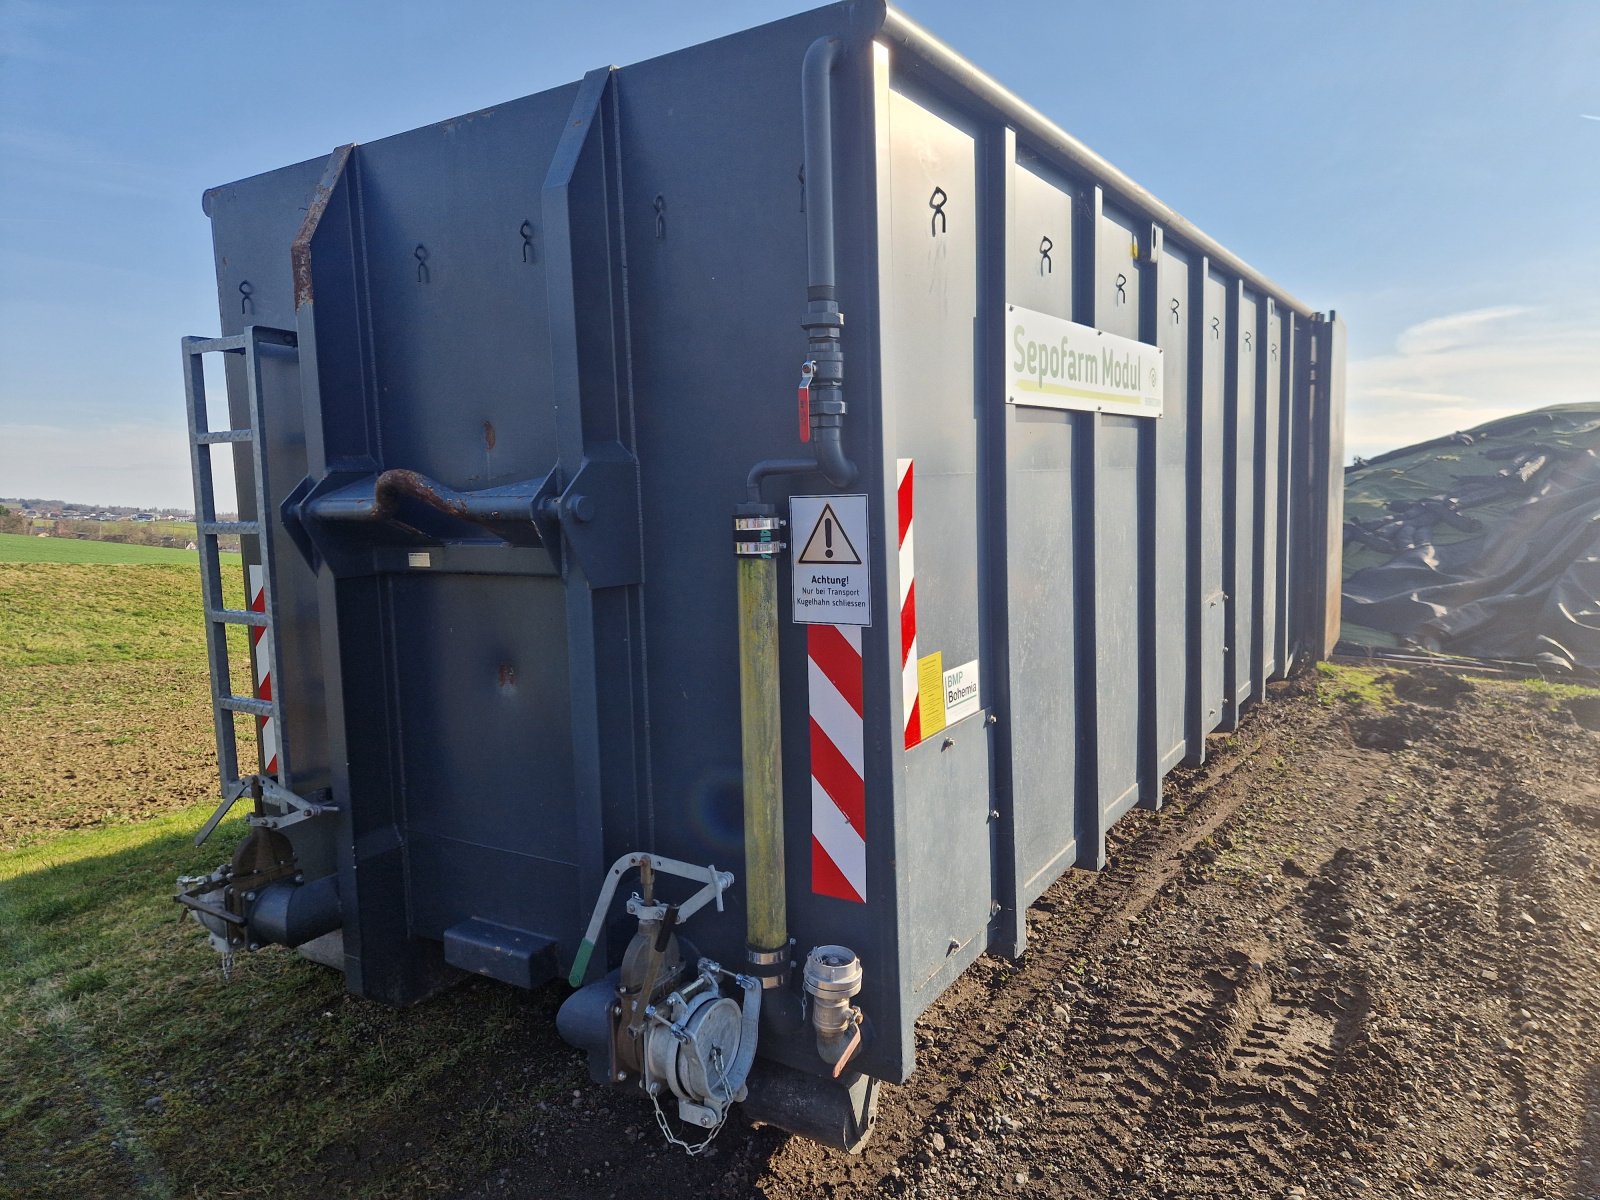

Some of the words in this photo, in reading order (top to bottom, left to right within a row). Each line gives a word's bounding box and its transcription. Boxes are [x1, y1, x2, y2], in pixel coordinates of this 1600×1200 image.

[1013, 325, 1098, 388] Sepofarm
[1102, 346, 1141, 391] Modul
[811, 575, 849, 587] Achtung!
[815, 587, 826, 595] bei
[827, 588, 860, 597] Transport
[797, 598, 830, 607] Kugelhahn
[832, 599, 866, 607] schliessen
[948, 671, 963, 688] BMP
[948, 682, 977, 703] Bohemia
